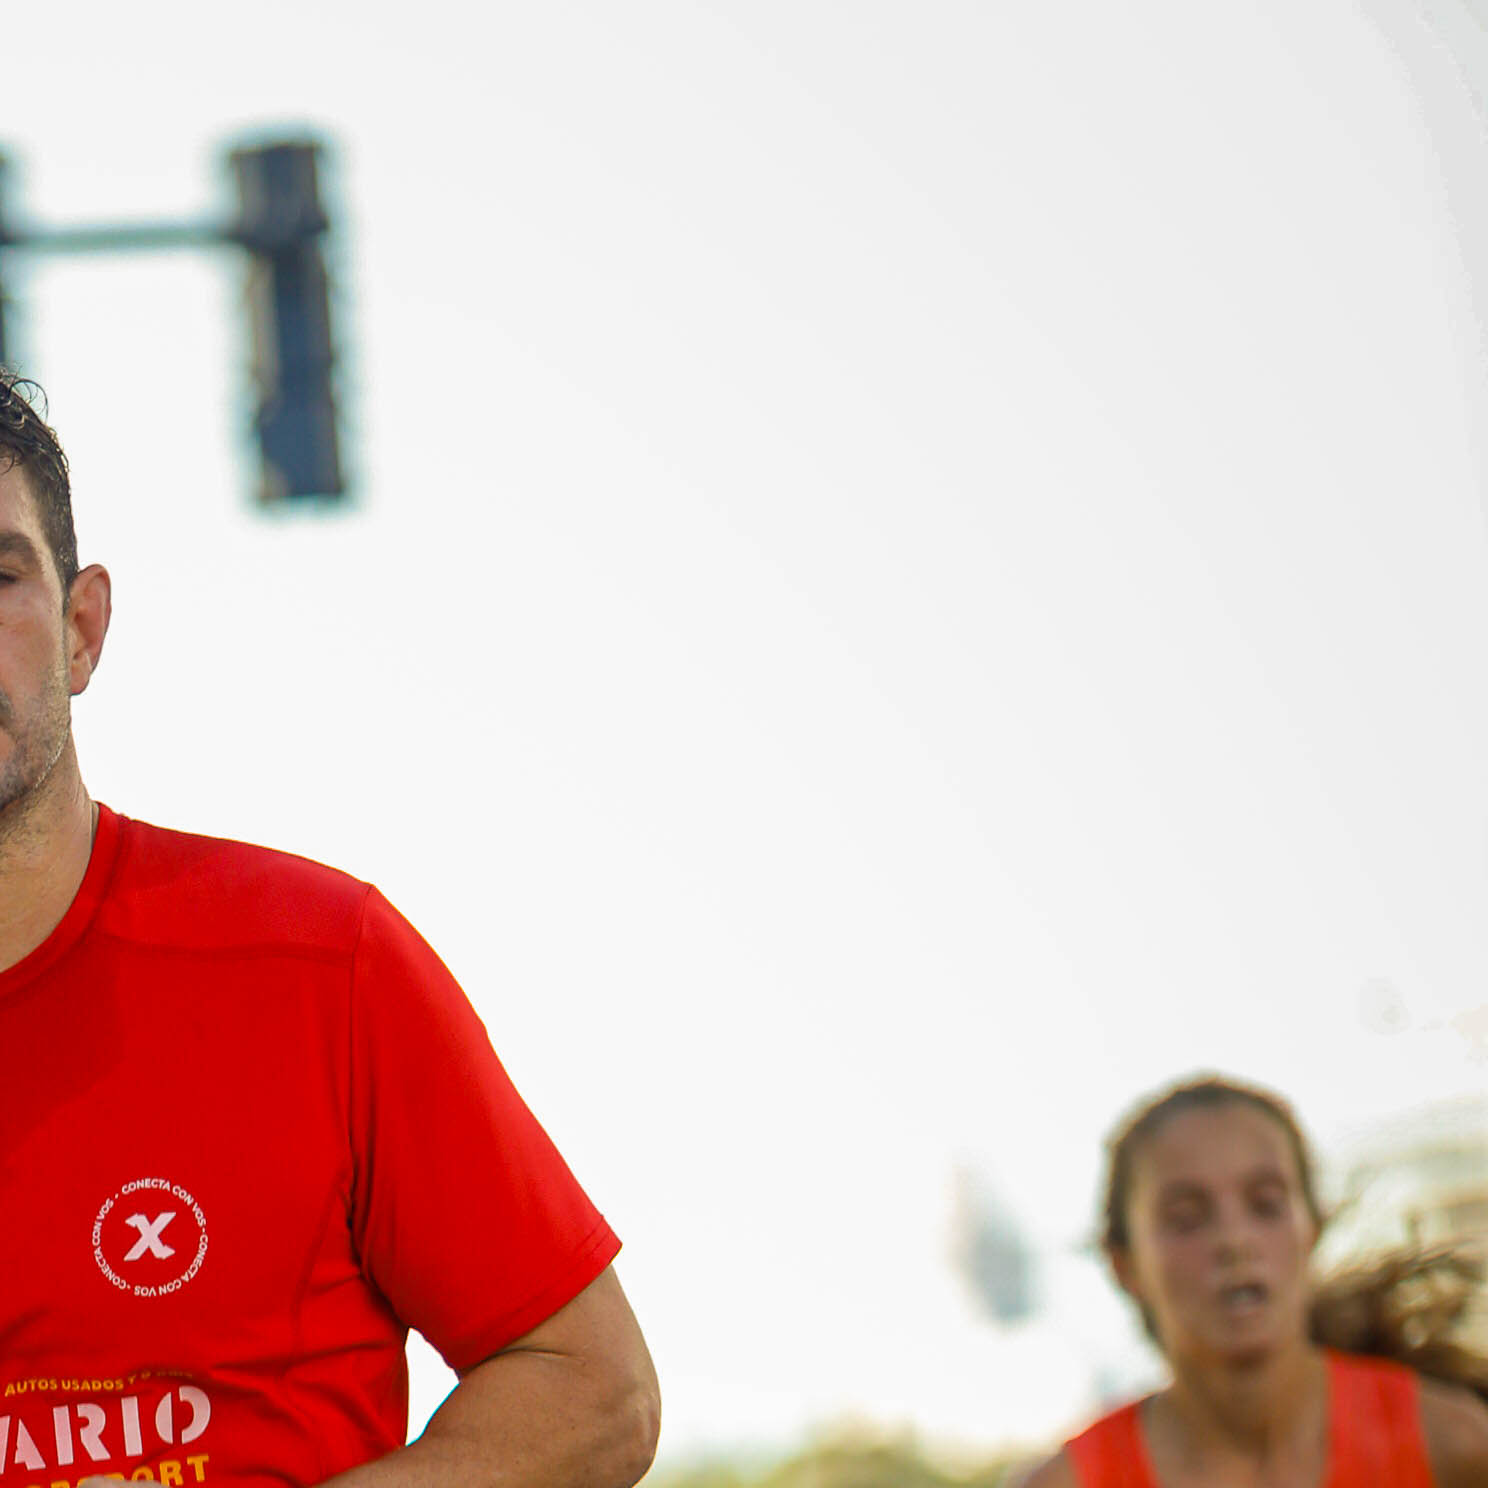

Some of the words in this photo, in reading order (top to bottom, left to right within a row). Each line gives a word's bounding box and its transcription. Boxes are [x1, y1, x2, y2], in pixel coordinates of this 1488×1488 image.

[96, 1198, 114, 1220] VOS
[121, 1178, 171, 1195] CONECTA
[172, 1185, 194, 1206] CON
[192, 1202, 207, 1228] VOS
[92, 1221, 103, 1246] CON
[123, 1211, 177, 1262] X
[93, 1246, 127, 1290] CONECTA
[181, 1234, 209, 1283] CONECTA
[134, 1285, 157, 1298] VOS
[158, 1279, 182, 1297] CON
[4, 1378, 58, 1399] AUTOS
[61, 1378, 125, 1393] USADOS
